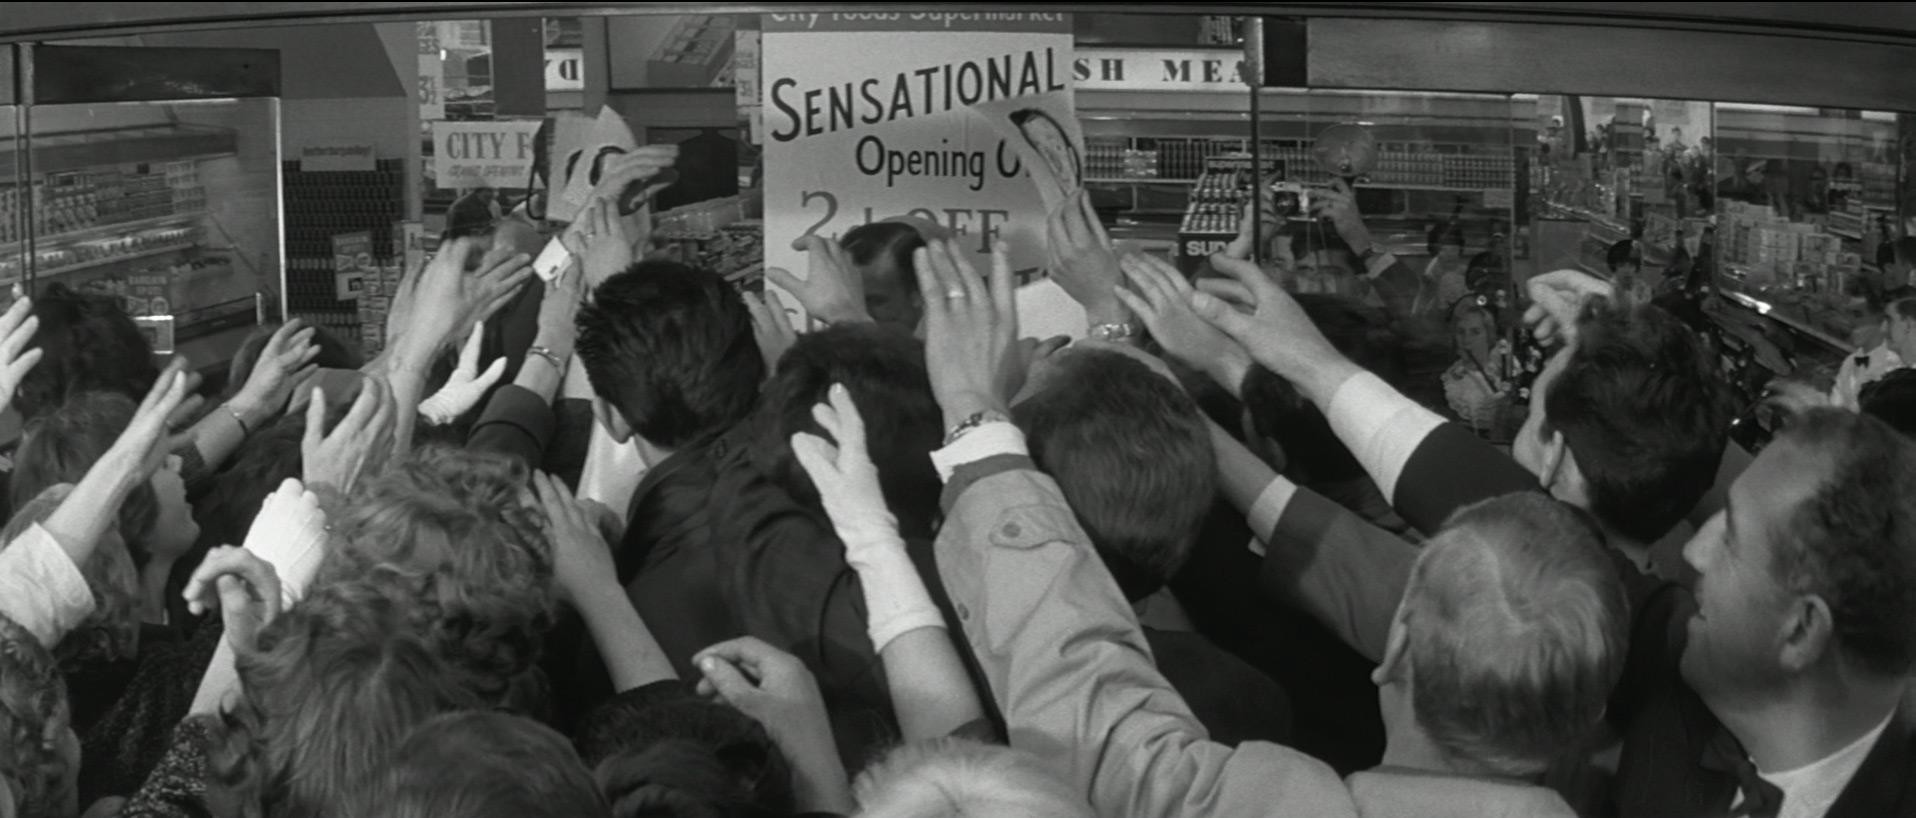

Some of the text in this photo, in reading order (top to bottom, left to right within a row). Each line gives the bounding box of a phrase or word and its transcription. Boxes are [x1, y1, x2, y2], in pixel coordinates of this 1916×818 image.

[770, 46, 1066, 142] SENSATIONAL
[446, 131, 507, 160] CITY
[855, 134, 1034, 191] Opening O
[906, 208, 1009, 254] FF
